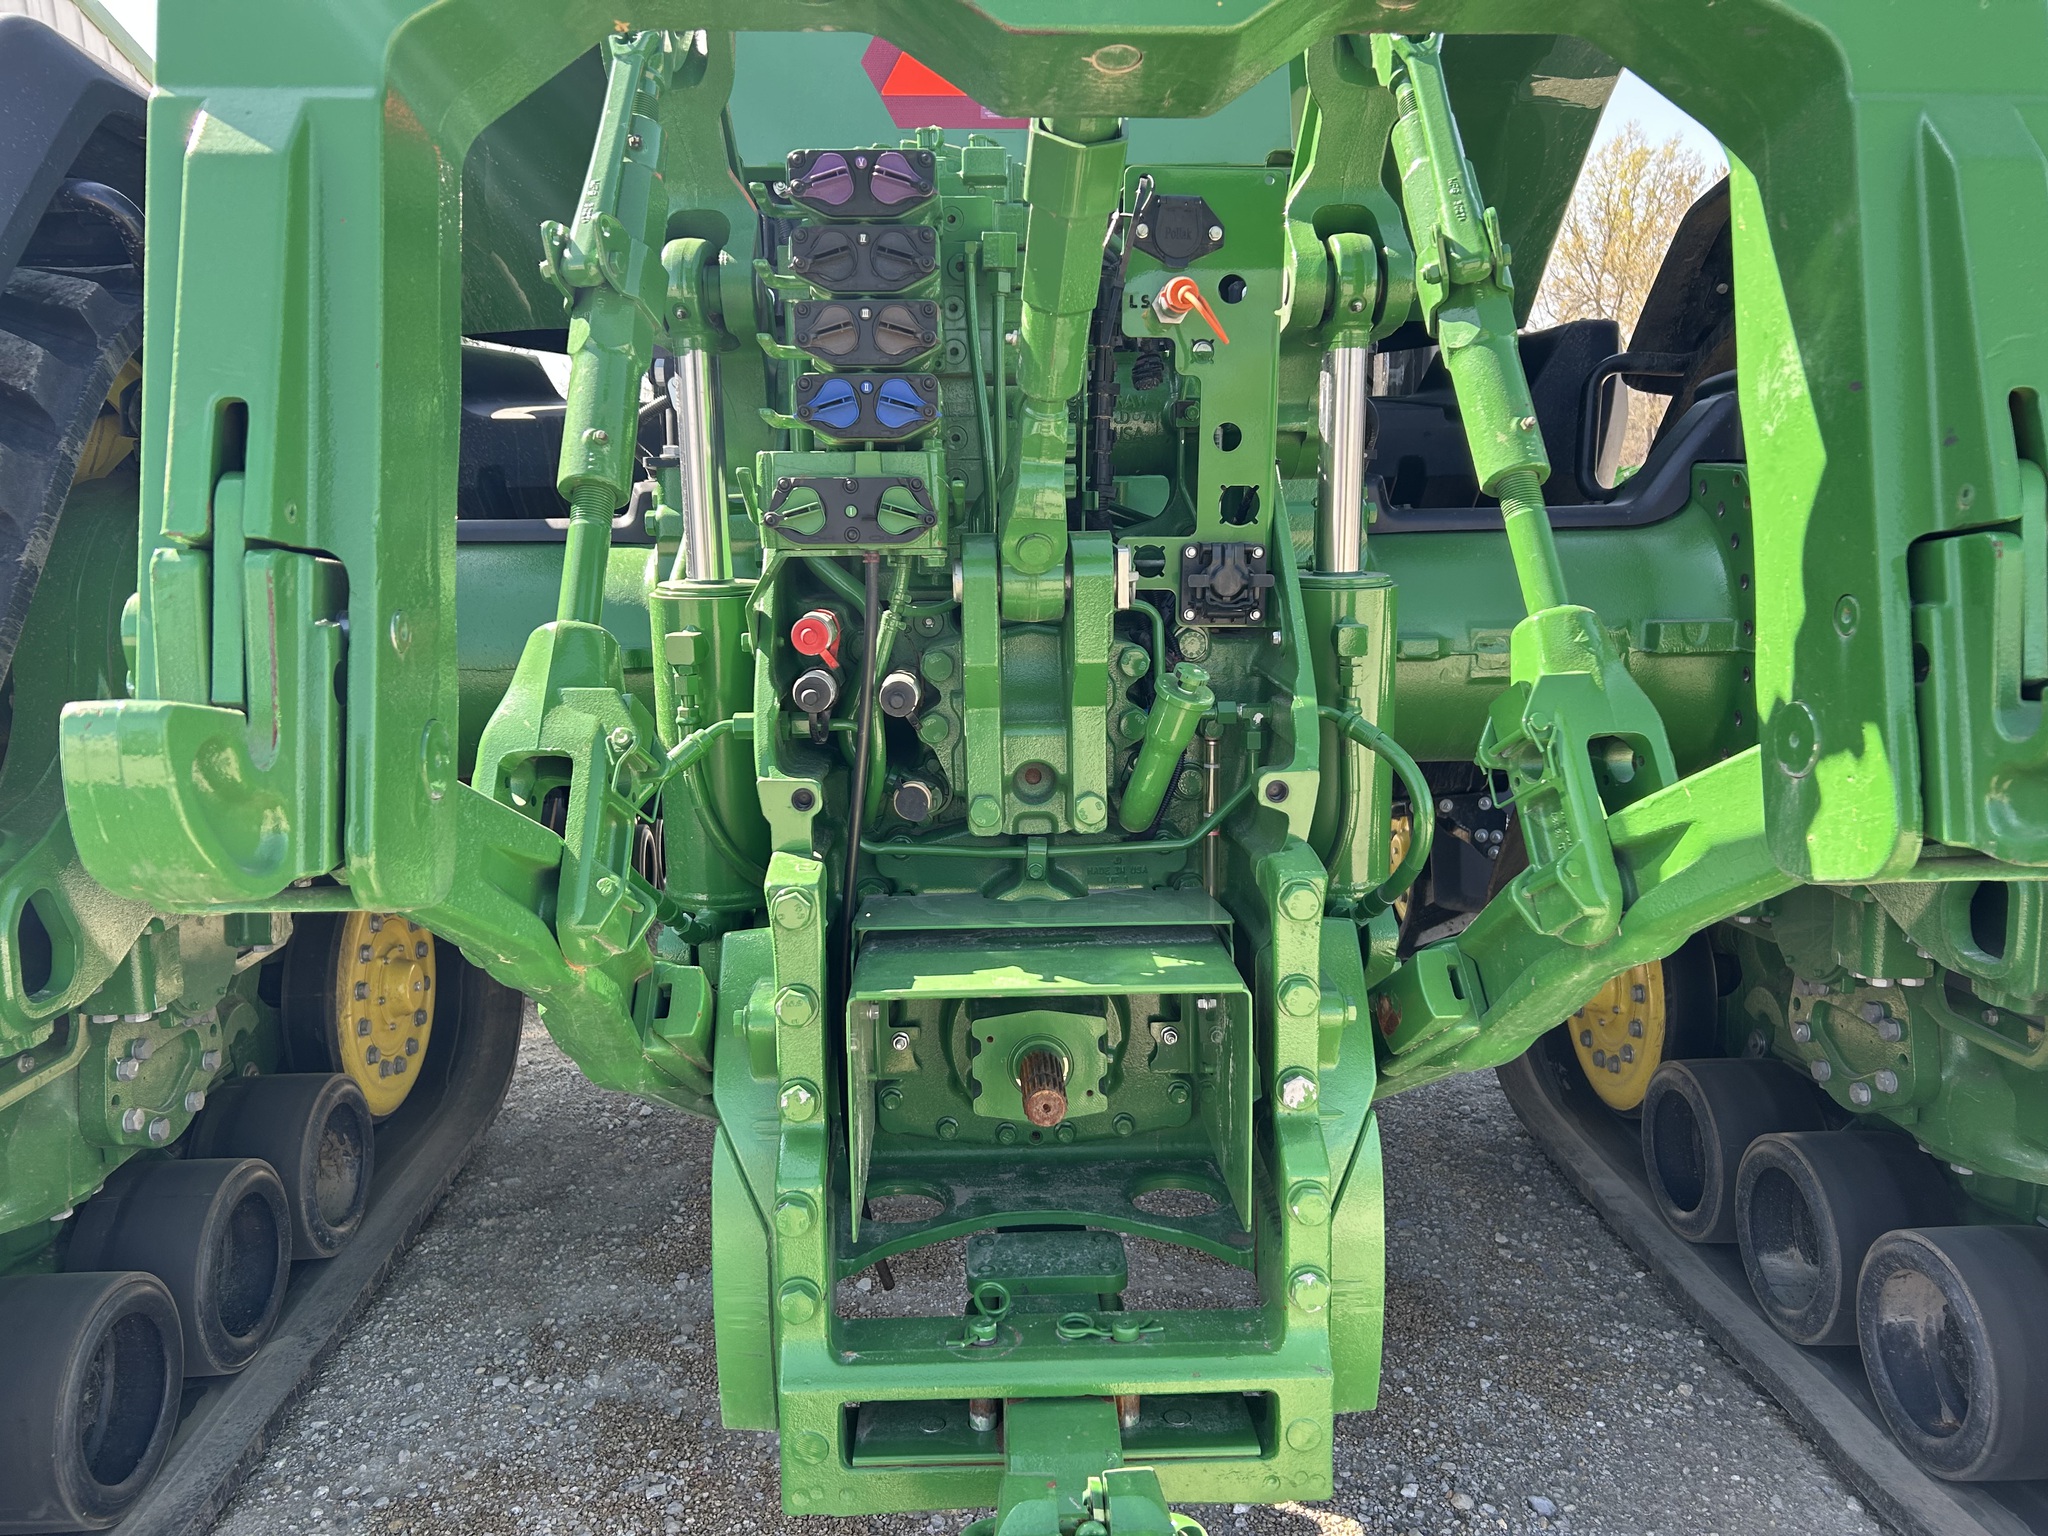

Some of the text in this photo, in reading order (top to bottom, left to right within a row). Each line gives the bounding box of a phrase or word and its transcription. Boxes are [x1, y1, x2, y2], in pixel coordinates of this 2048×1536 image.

[858, 157, 865, 167] V
[1164, 226, 1193, 241] Pollak
[1129, 294, 1151, 309] LS
[861, 308, 870, 318] III
[864, 383, 869, 392] II
